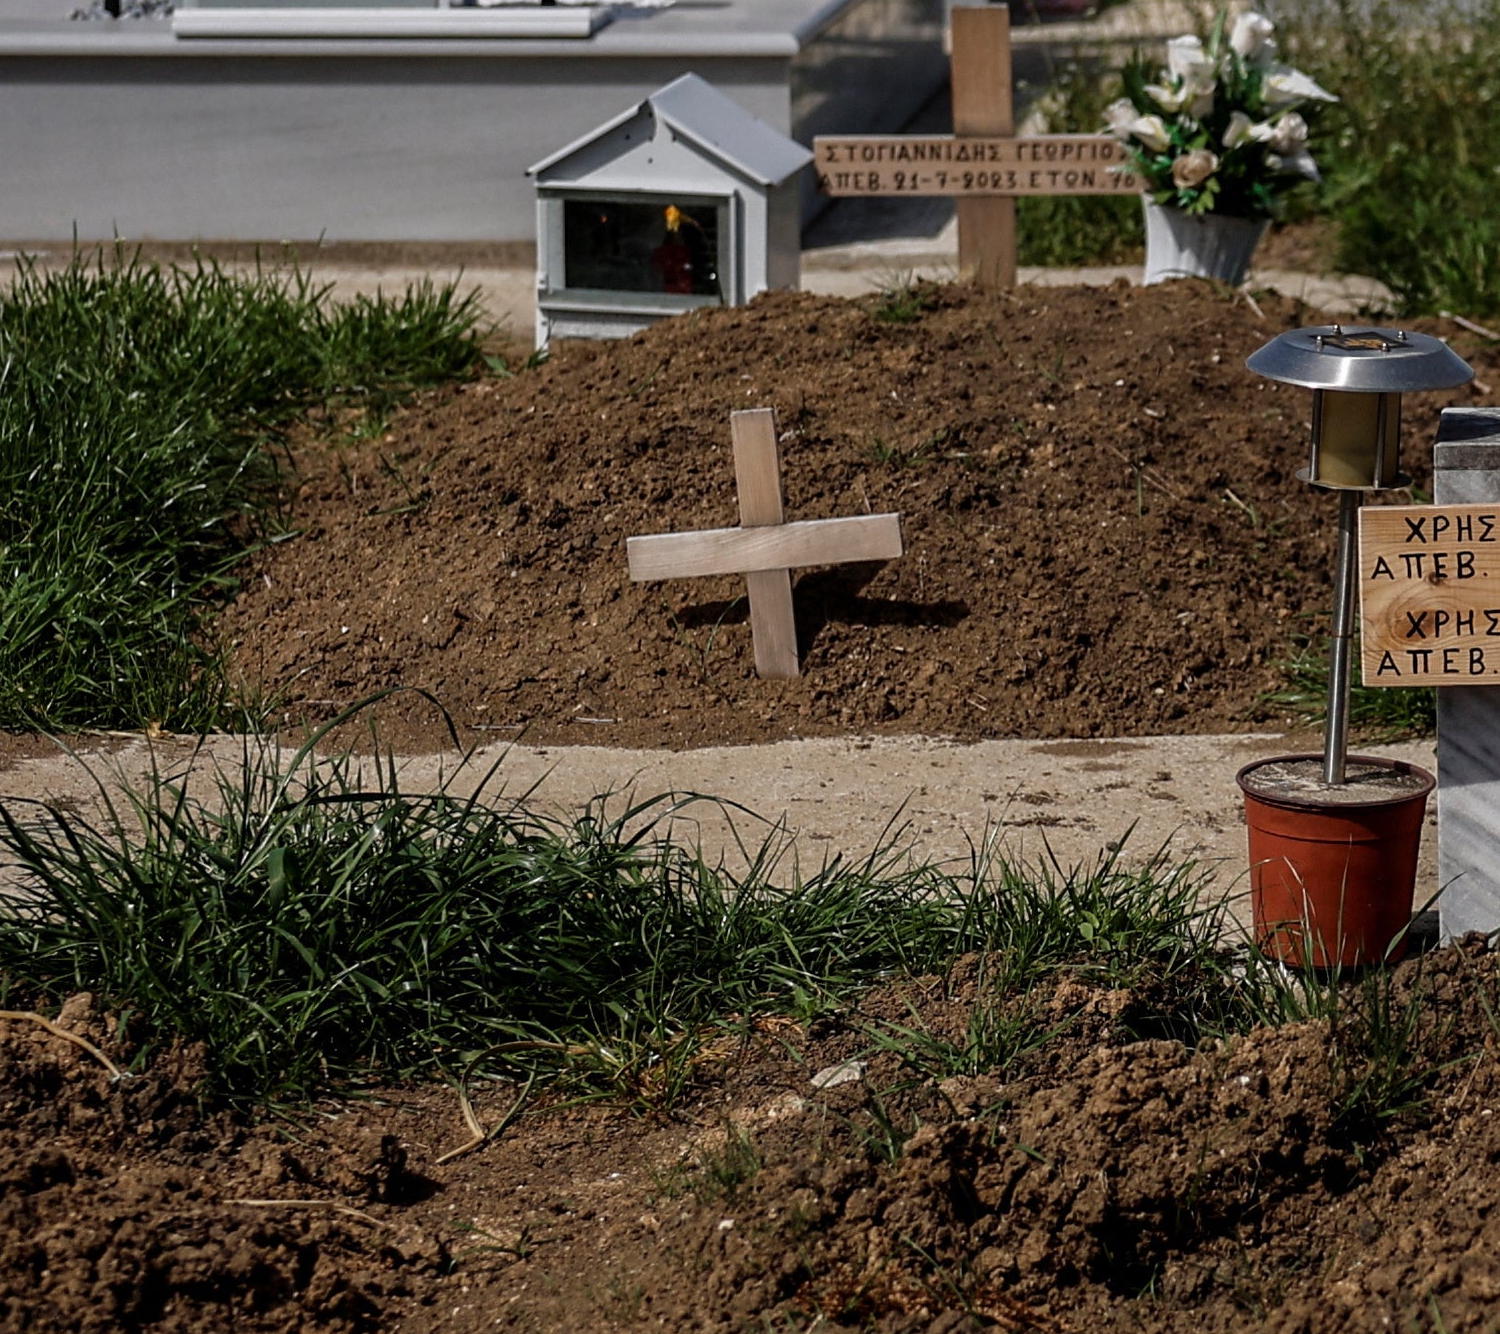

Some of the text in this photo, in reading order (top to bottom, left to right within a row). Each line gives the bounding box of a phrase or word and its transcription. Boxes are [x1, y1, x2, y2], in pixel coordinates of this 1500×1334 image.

[825, 142, 1000, 163] ΣΤΟΓΙΑΝΝΙΔΗΣ
[1370, 552, 1490, 581] ΑΠΕΒ.
[1377, 649, 1498, 677] ΑΠΕΒ.
